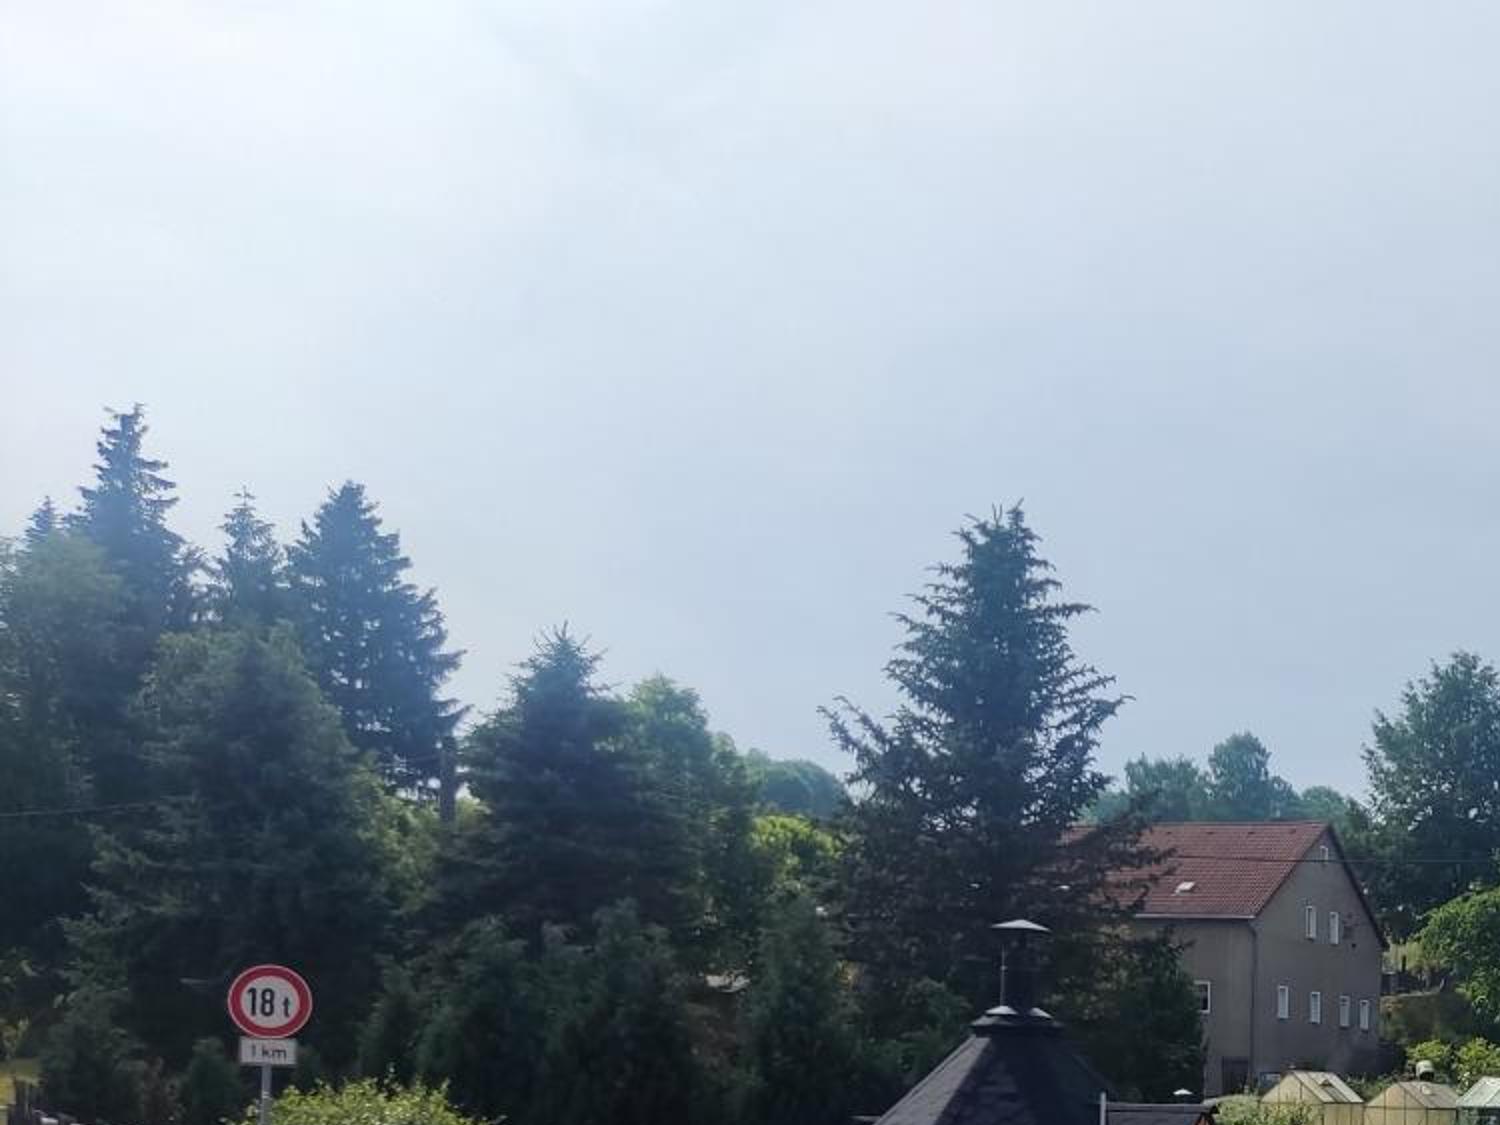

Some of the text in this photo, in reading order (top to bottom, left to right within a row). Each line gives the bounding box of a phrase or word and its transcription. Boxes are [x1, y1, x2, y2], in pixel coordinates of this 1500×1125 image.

[247, 987, 291, 1017] 18 t
[261, 1044, 287, 1058] km
